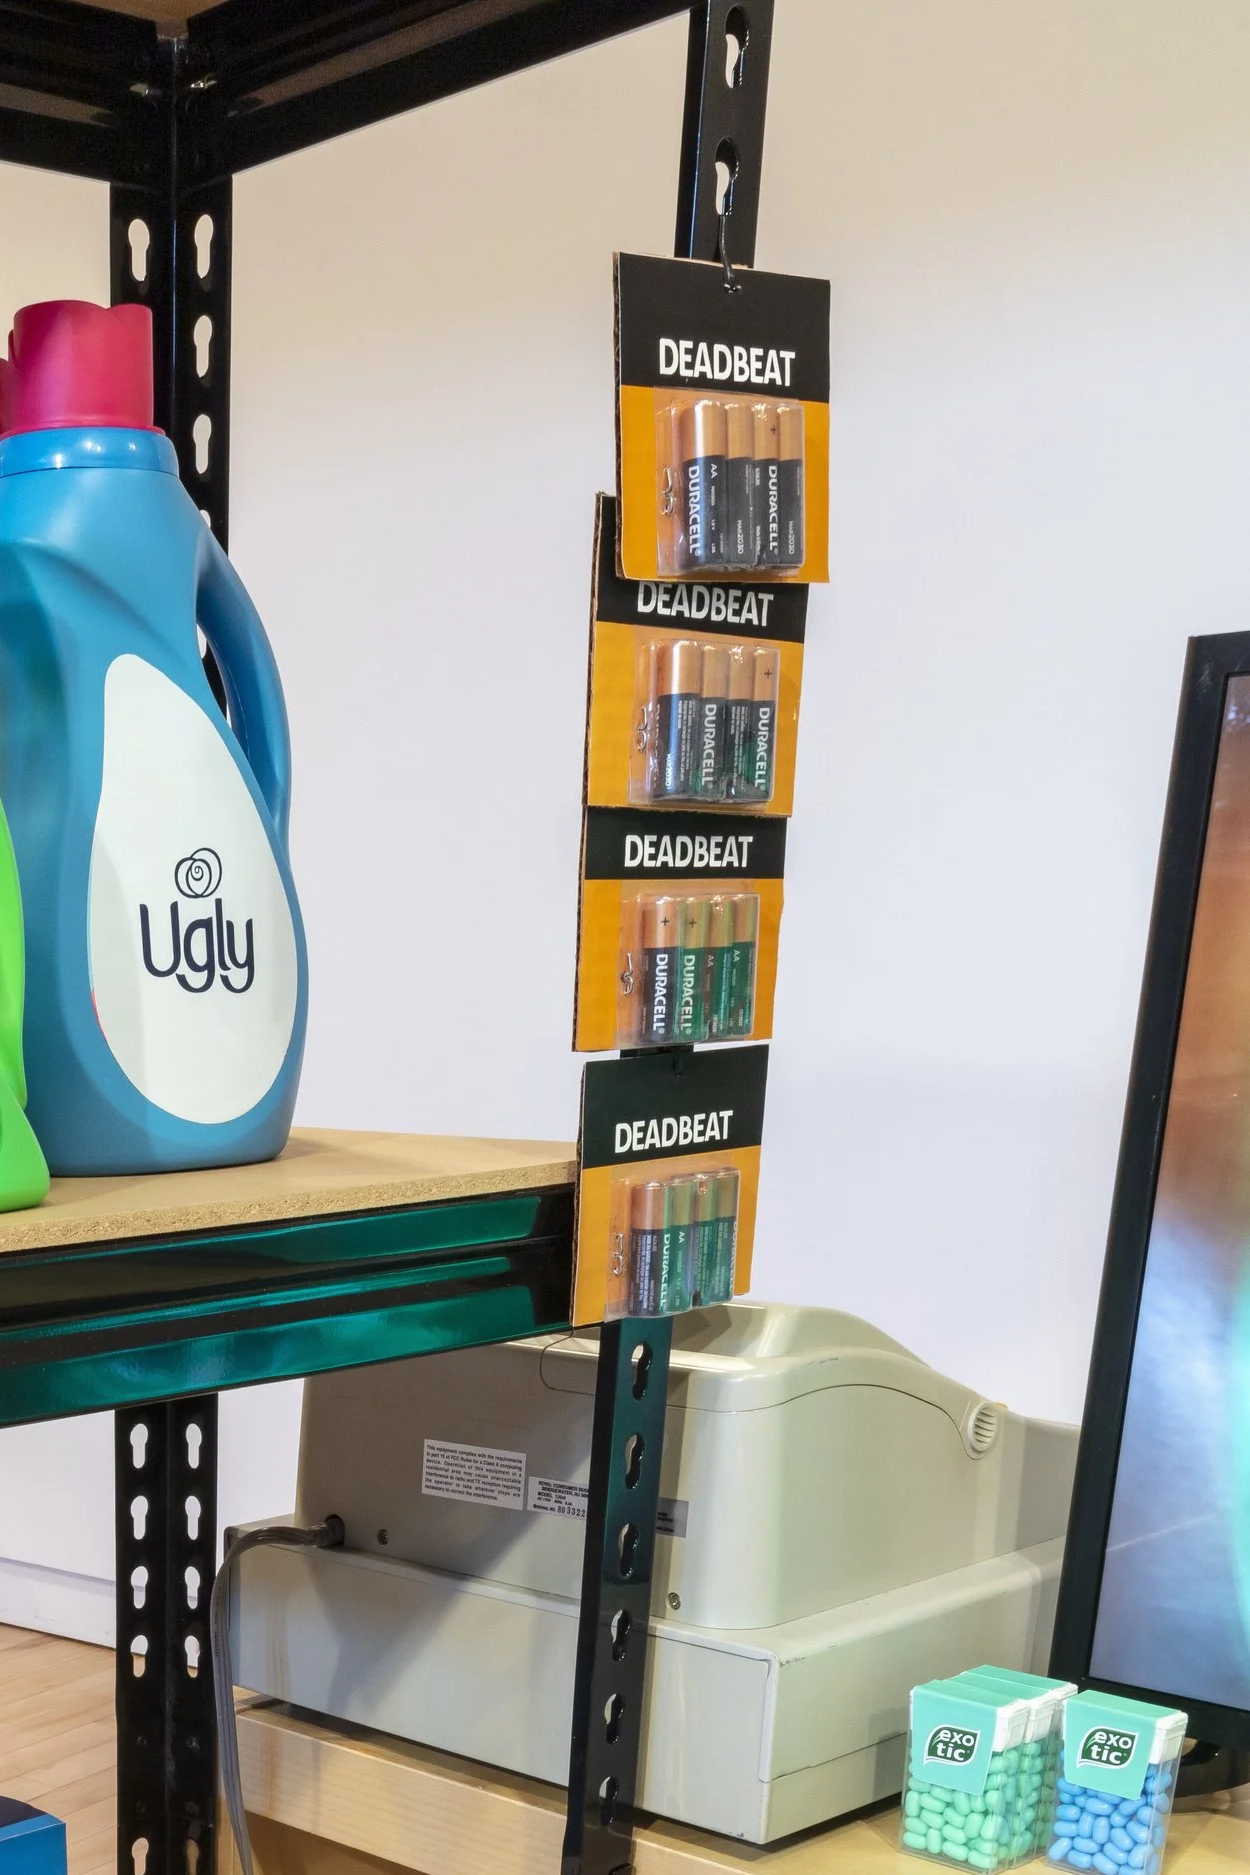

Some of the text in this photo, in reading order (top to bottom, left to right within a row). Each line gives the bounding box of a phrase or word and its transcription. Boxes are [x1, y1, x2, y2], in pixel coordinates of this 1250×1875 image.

[658, 338, 796, 387] DEADBEAT
[710, 463, 718, 479] AA
[688, 465, 700, 554] DURACELL
[768, 465, 778, 552] DURACELL
[637, 582, 774, 627] DEADBEAT
[701, 704, 717, 786] DURACELL
[754, 707, 770, 788] DURACELL
[624, 834, 754, 868] DEADBEAT
[139, 898, 255, 994] Ugly
[732, 949, 740, 962] AA
[653, 953, 668, 1031] DURACELL
[680, 954, 695, 1031] DURACELL
[614, 1109, 734, 1154] DEADBEAT
[678, 1231, 685, 1244] AA
[660, 1233, 671, 1307] DURACELL
[936, 1742, 966, 1762] tic
[938, 1728, 976, 1747] exo
[1090, 1745, 1122, 1765] tic
[1093, 1730, 1133, 1750] exo
